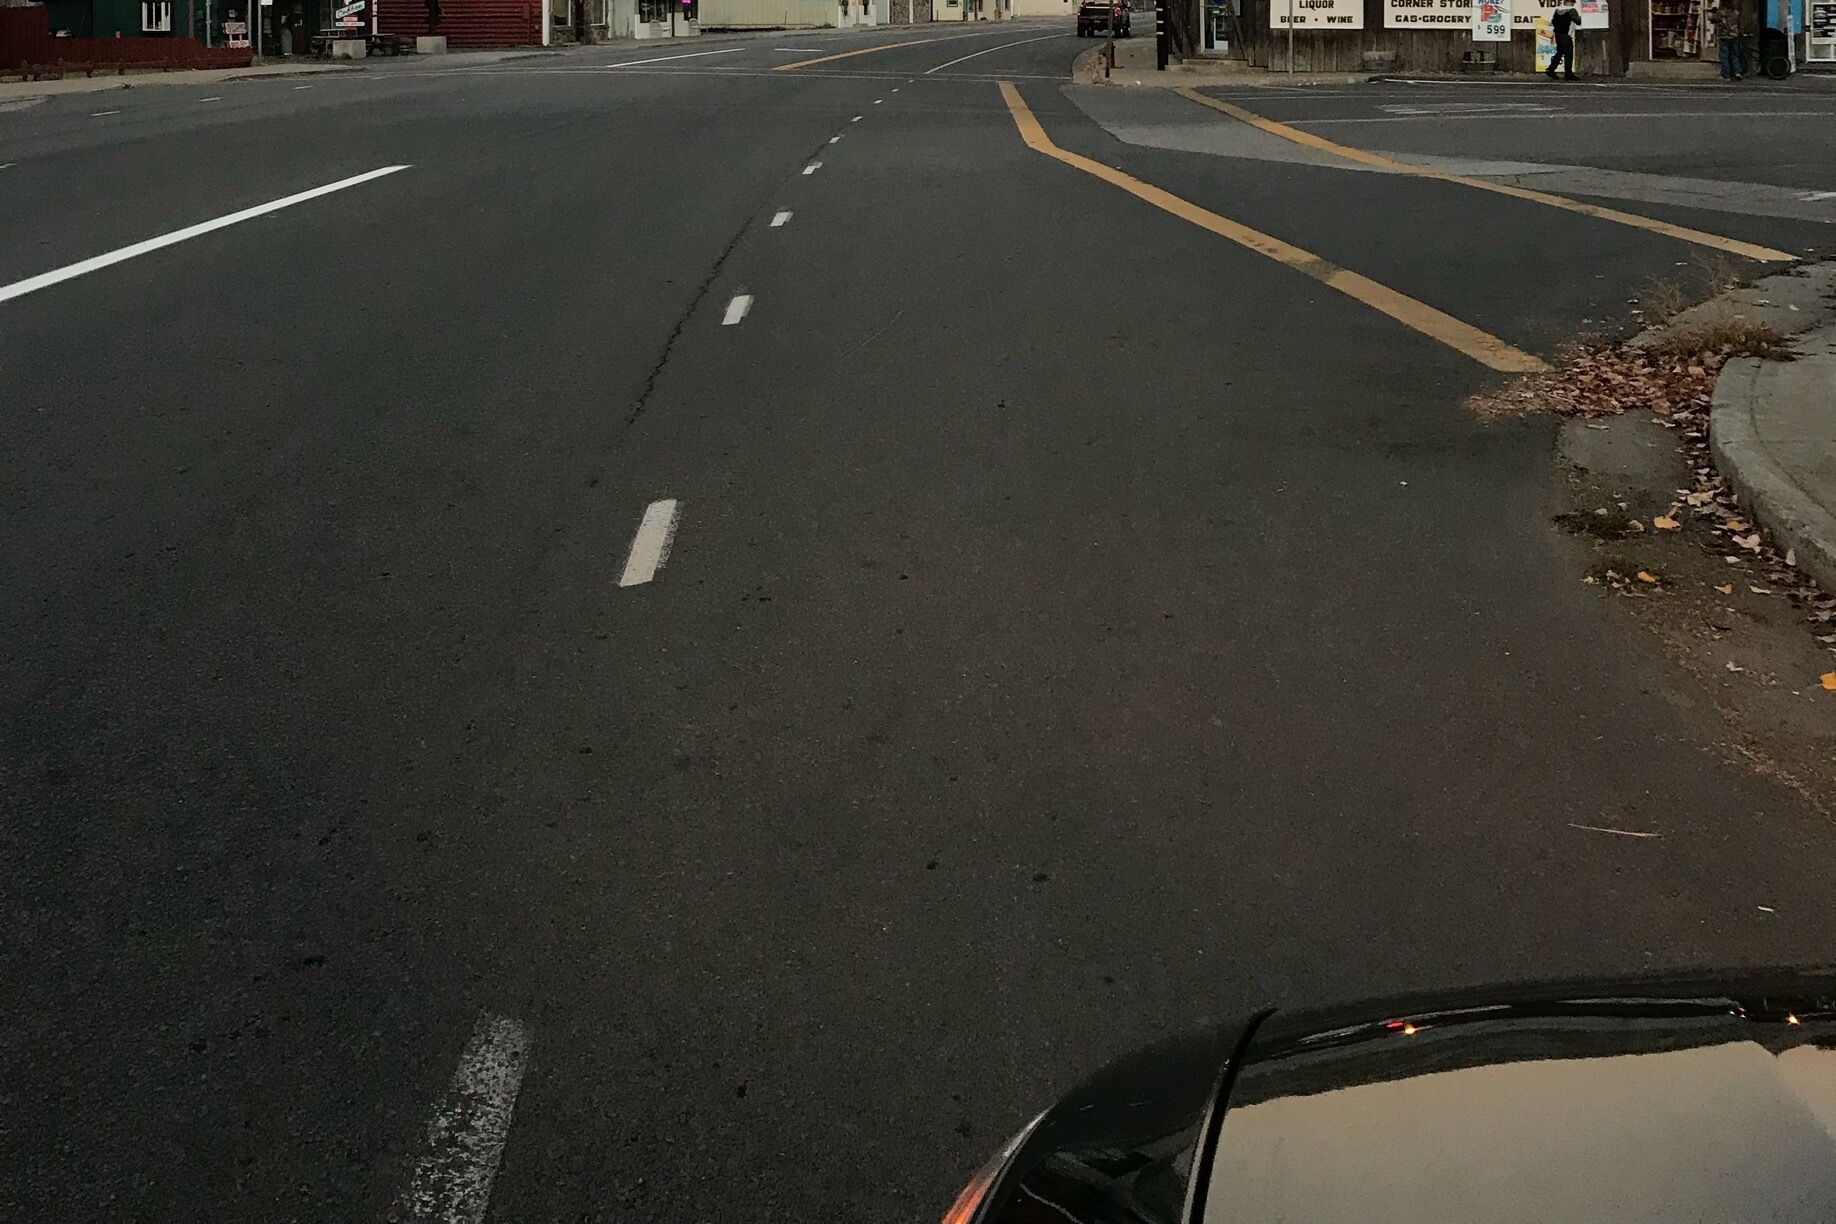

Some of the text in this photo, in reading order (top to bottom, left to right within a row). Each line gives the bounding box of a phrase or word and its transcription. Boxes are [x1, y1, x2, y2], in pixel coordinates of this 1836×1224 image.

[1299, 0, 1334, 10] LIQUOR
[1391, 0, 1434, 8] CORNER
[1327, 16, 1353, 24] WINE
[1486, 25, 1506, 35] 599
